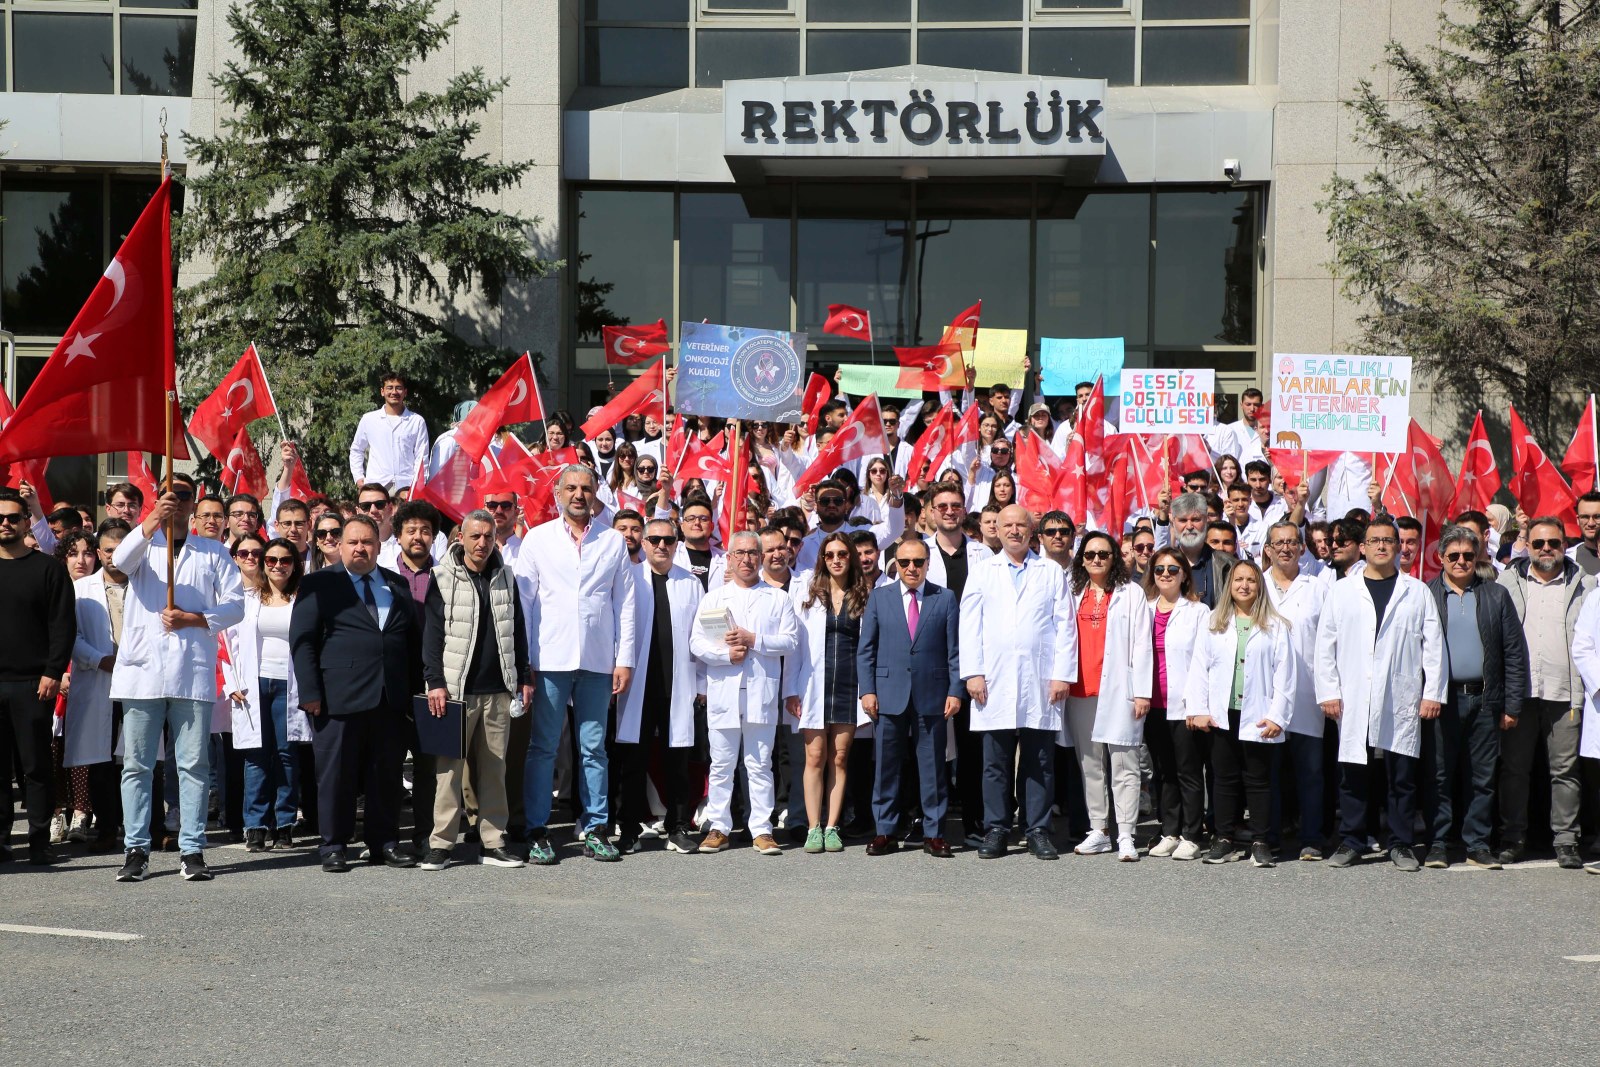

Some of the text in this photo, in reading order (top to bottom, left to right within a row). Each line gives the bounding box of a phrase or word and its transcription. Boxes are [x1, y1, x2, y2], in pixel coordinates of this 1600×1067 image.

[741, 89, 1102, 140] REKTÖRLÜK
[686, 341, 730, 353] VETERİNER
[684, 354, 730, 366] ONKOLOJİ
[1304, 359, 1393, 377] SAĞLIKLI
[688, 367, 721, 378] KULÜBÜ
[1132, 371, 1195, 390] SESSİZ
[1277, 376, 1408, 398] YARINLAR İÇİN
[1123, 391, 1216, 408] DOSTLARIN
[1278, 394, 1381, 415] VETERİNER
[1124, 406, 1174, 427] GÜÇLÜ
[1291, 412, 1387, 437] HEKİMLER!
